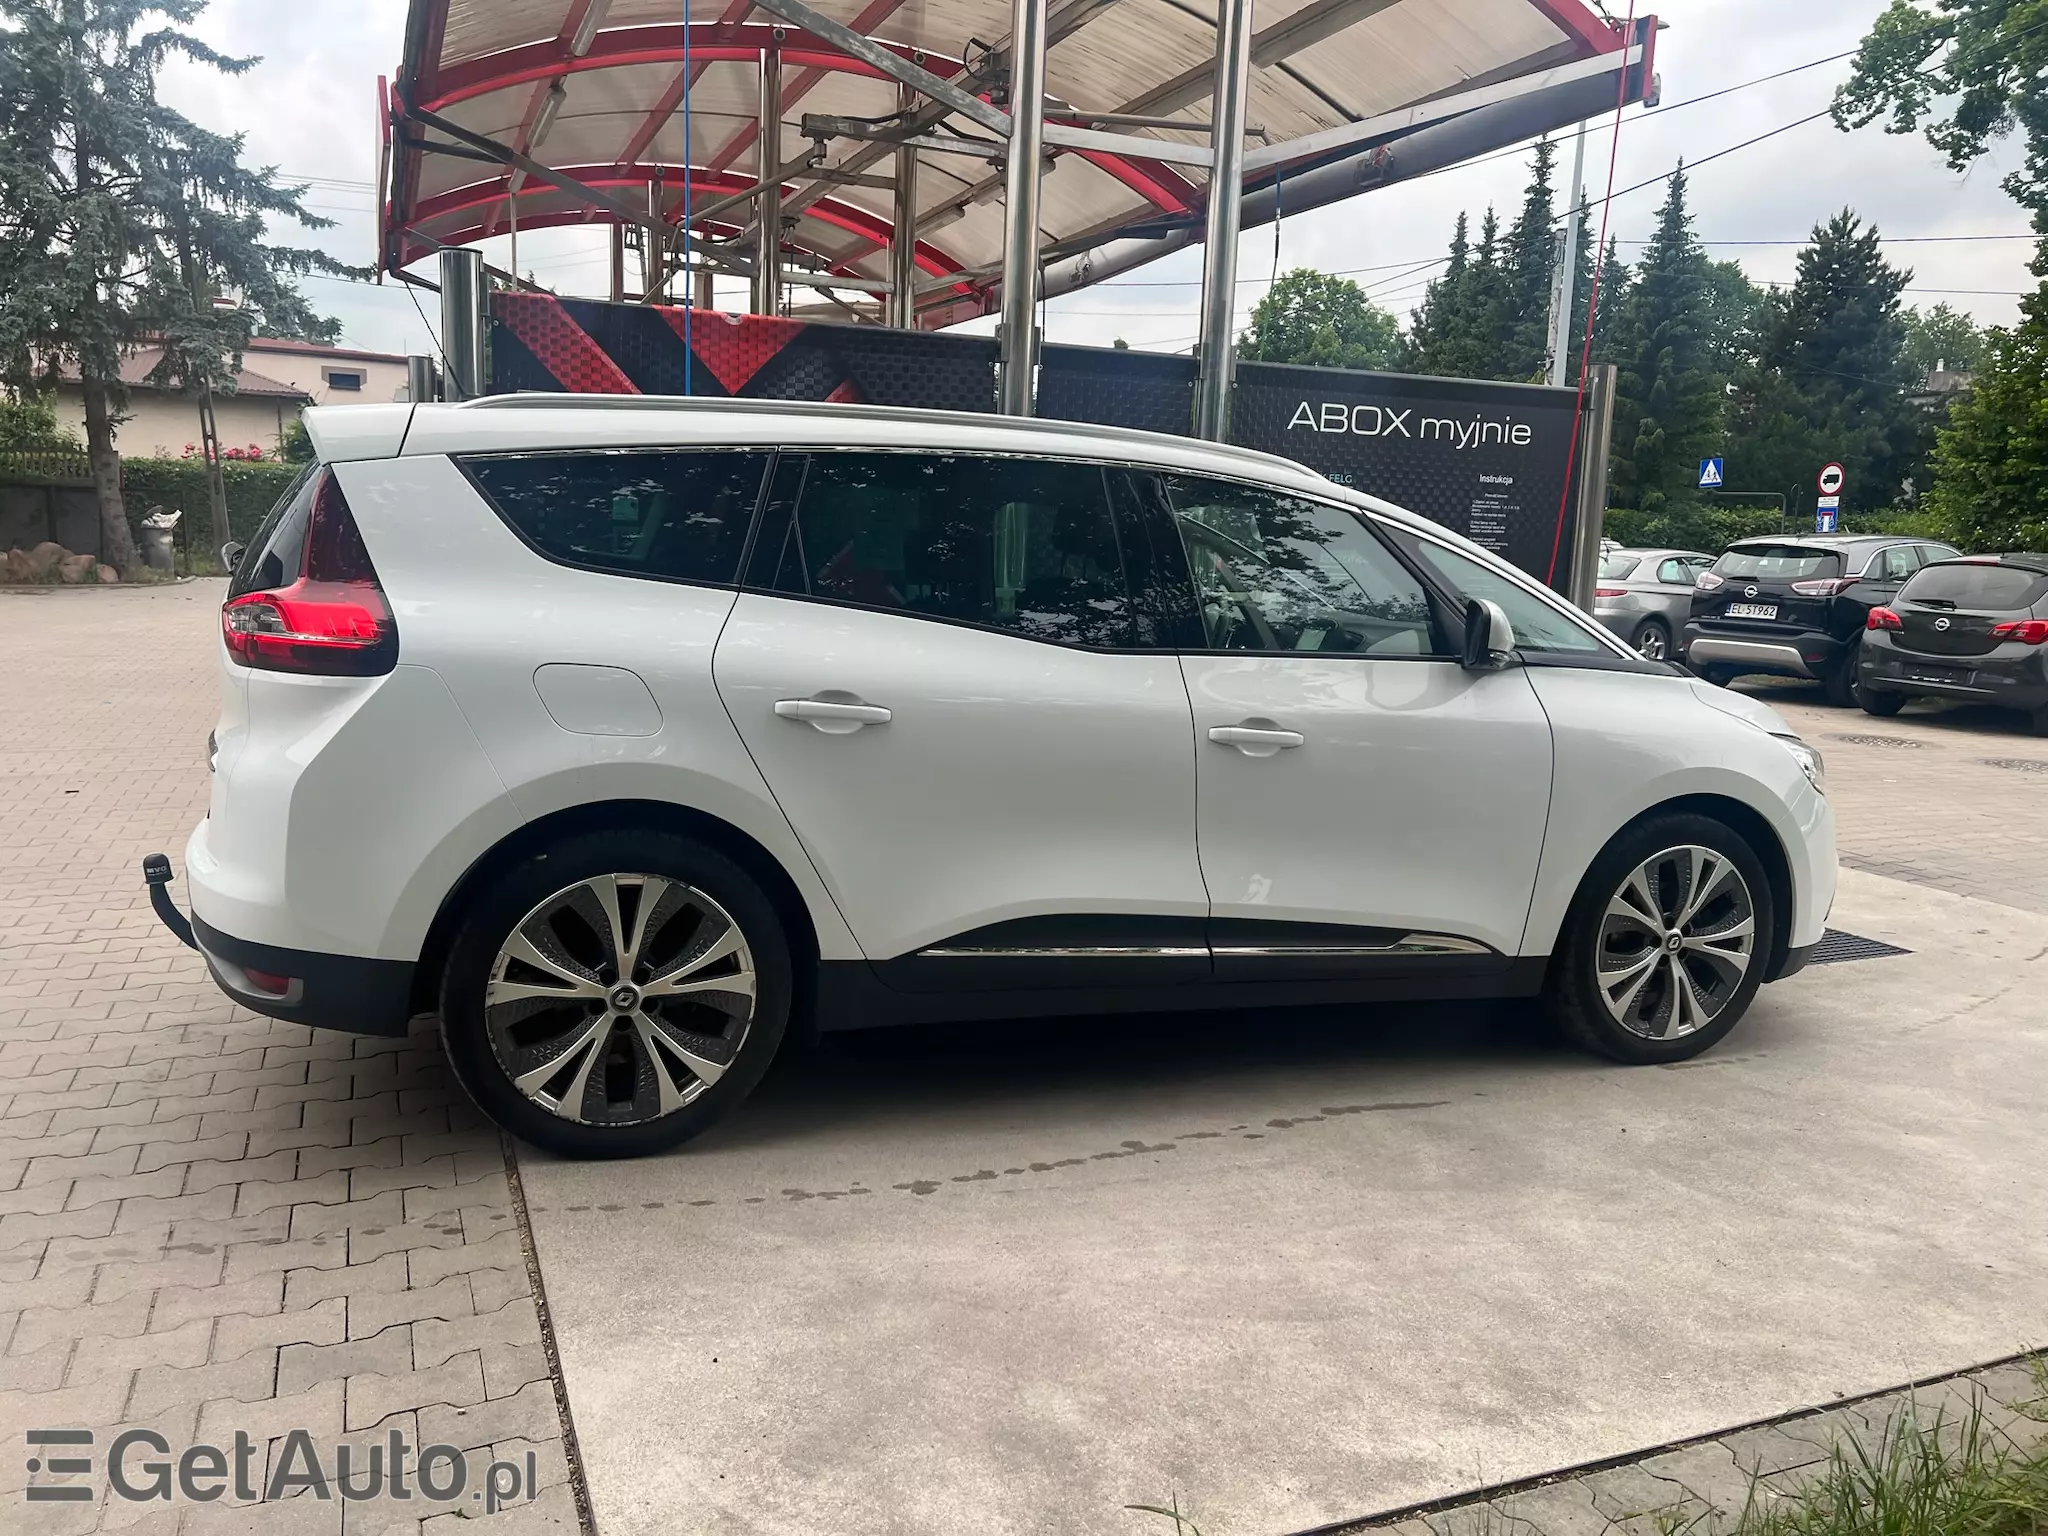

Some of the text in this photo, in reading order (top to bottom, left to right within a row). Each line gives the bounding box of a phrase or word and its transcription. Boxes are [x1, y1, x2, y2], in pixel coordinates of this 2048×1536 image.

[1287, 401, 1532, 449] ABOX myjnie
[1479, 474, 1513, 485] Instrukcja
[1731, 604, 1776, 617] EL 5T962
